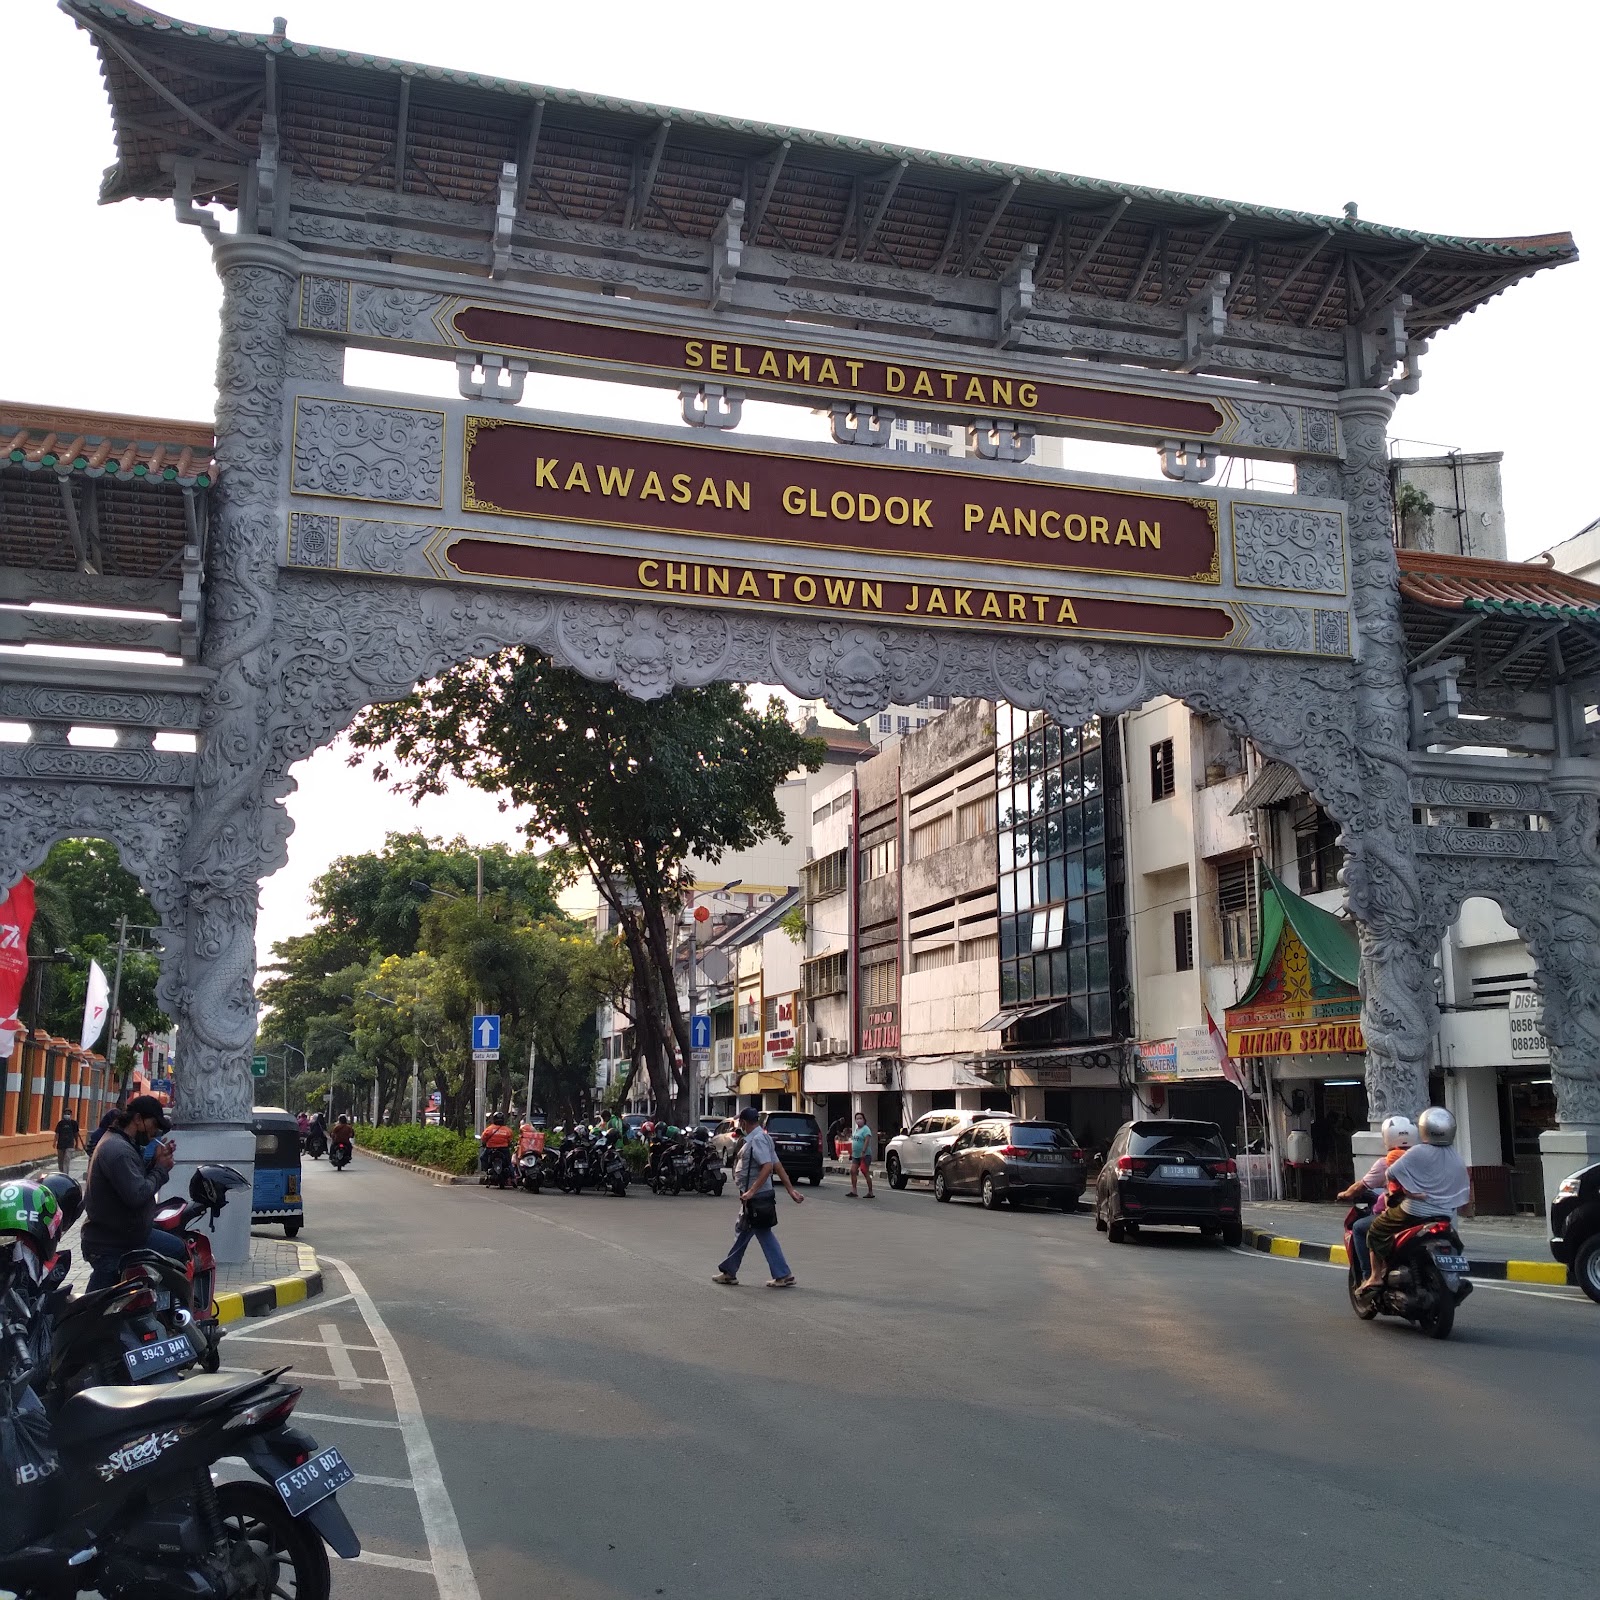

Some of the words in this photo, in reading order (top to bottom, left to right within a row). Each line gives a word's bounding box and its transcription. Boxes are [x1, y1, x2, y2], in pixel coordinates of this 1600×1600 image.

[685, 341, 864, 388] SELAMAT
[886, 366, 1038, 408] DATANG
[535, 457, 750, 511] KAWASAN
[782, 485, 934, 528] GLODOK
[963, 503, 1161, 549] PANCORAN
[638, 561, 883, 609] CHINATOWN
[905, 585, 1078, 624] JAKARTA
[869, 1012, 893, 1025] TOKO
[862, 1028, 882, 1050] MAJU
[1140, 1045, 1156, 1057] TOKO
[1158, 1043, 1175, 1055] OBAT
[1238, 1032, 1292, 1055] MINANG
[1142, 1059, 1176, 1072] SUMATERA
[16, 1210, 39, 1222] CE
[129, 1354, 137, 1366] B
[142, 1346, 165, 1360] 5943
[168, 1340, 185, 1353] BAV
[16, 1458, 59, 1486] iBox
[280, 1482, 291, 1497] B
[290, 1465, 319, 1489] 5318
[319, 1450, 342, 1471] BDZ
